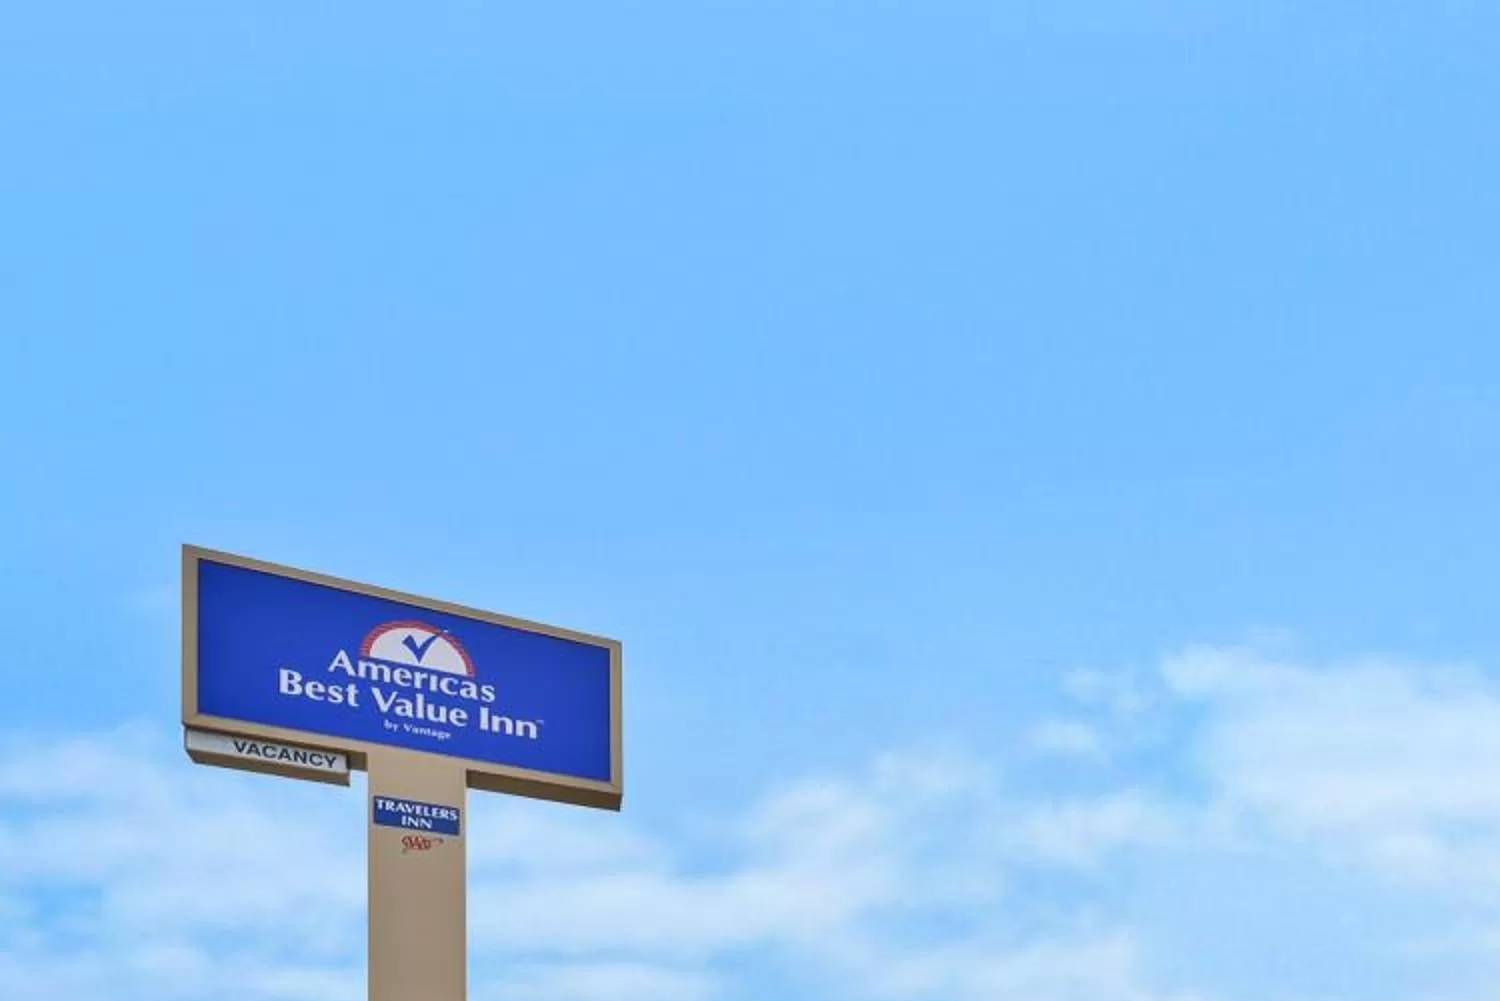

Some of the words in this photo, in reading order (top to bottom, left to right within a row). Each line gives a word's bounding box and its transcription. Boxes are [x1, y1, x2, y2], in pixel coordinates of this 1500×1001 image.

[328, 650, 495, 702] Americas
[279, 668, 360, 707] Best
[371, 687, 468, 727] Value
[480, 707, 538, 739] Inn
[384, 719, 398, 733] by
[403, 723, 451, 740] Vantage
[233, 740, 336, 768] VACANCY
[376, 799, 457, 820] TRAVELERS
[401, 815, 433, 829] INN
